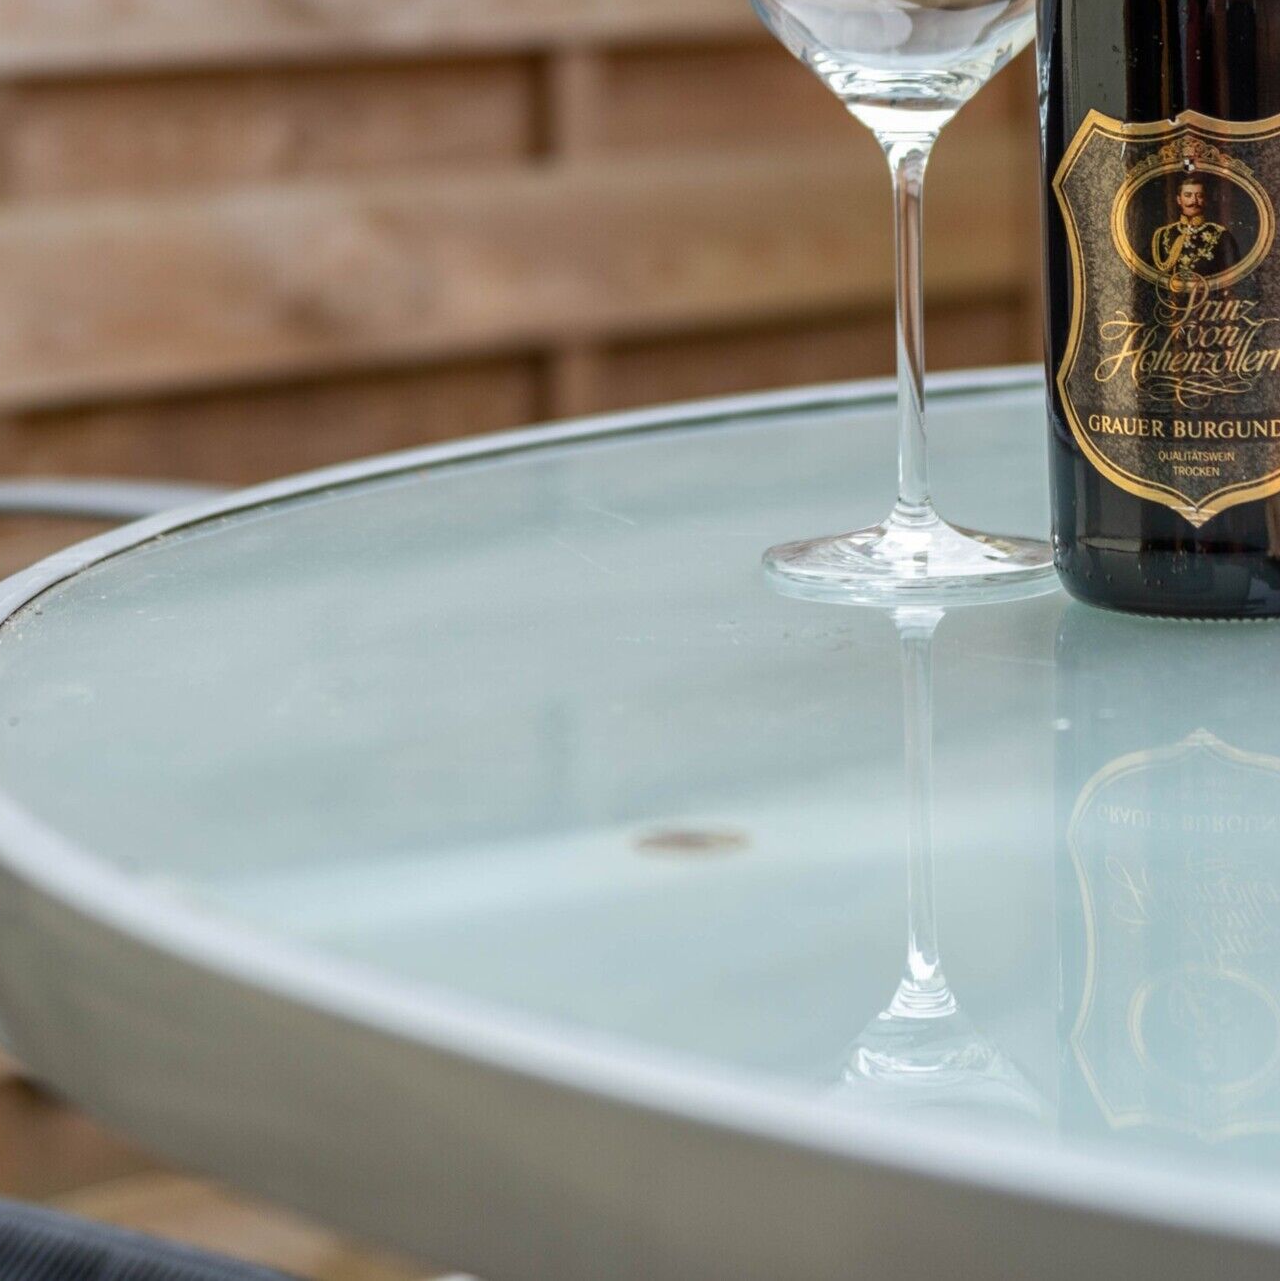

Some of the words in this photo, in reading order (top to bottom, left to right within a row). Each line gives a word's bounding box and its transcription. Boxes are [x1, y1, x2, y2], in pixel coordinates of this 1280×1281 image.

[1153, 271, 1280, 327] Prinz
[1183, 320, 1241, 349] von
[1088, 414, 1165, 438] GRAUER
[1173, 465, 1221, 477] TROCKEN
